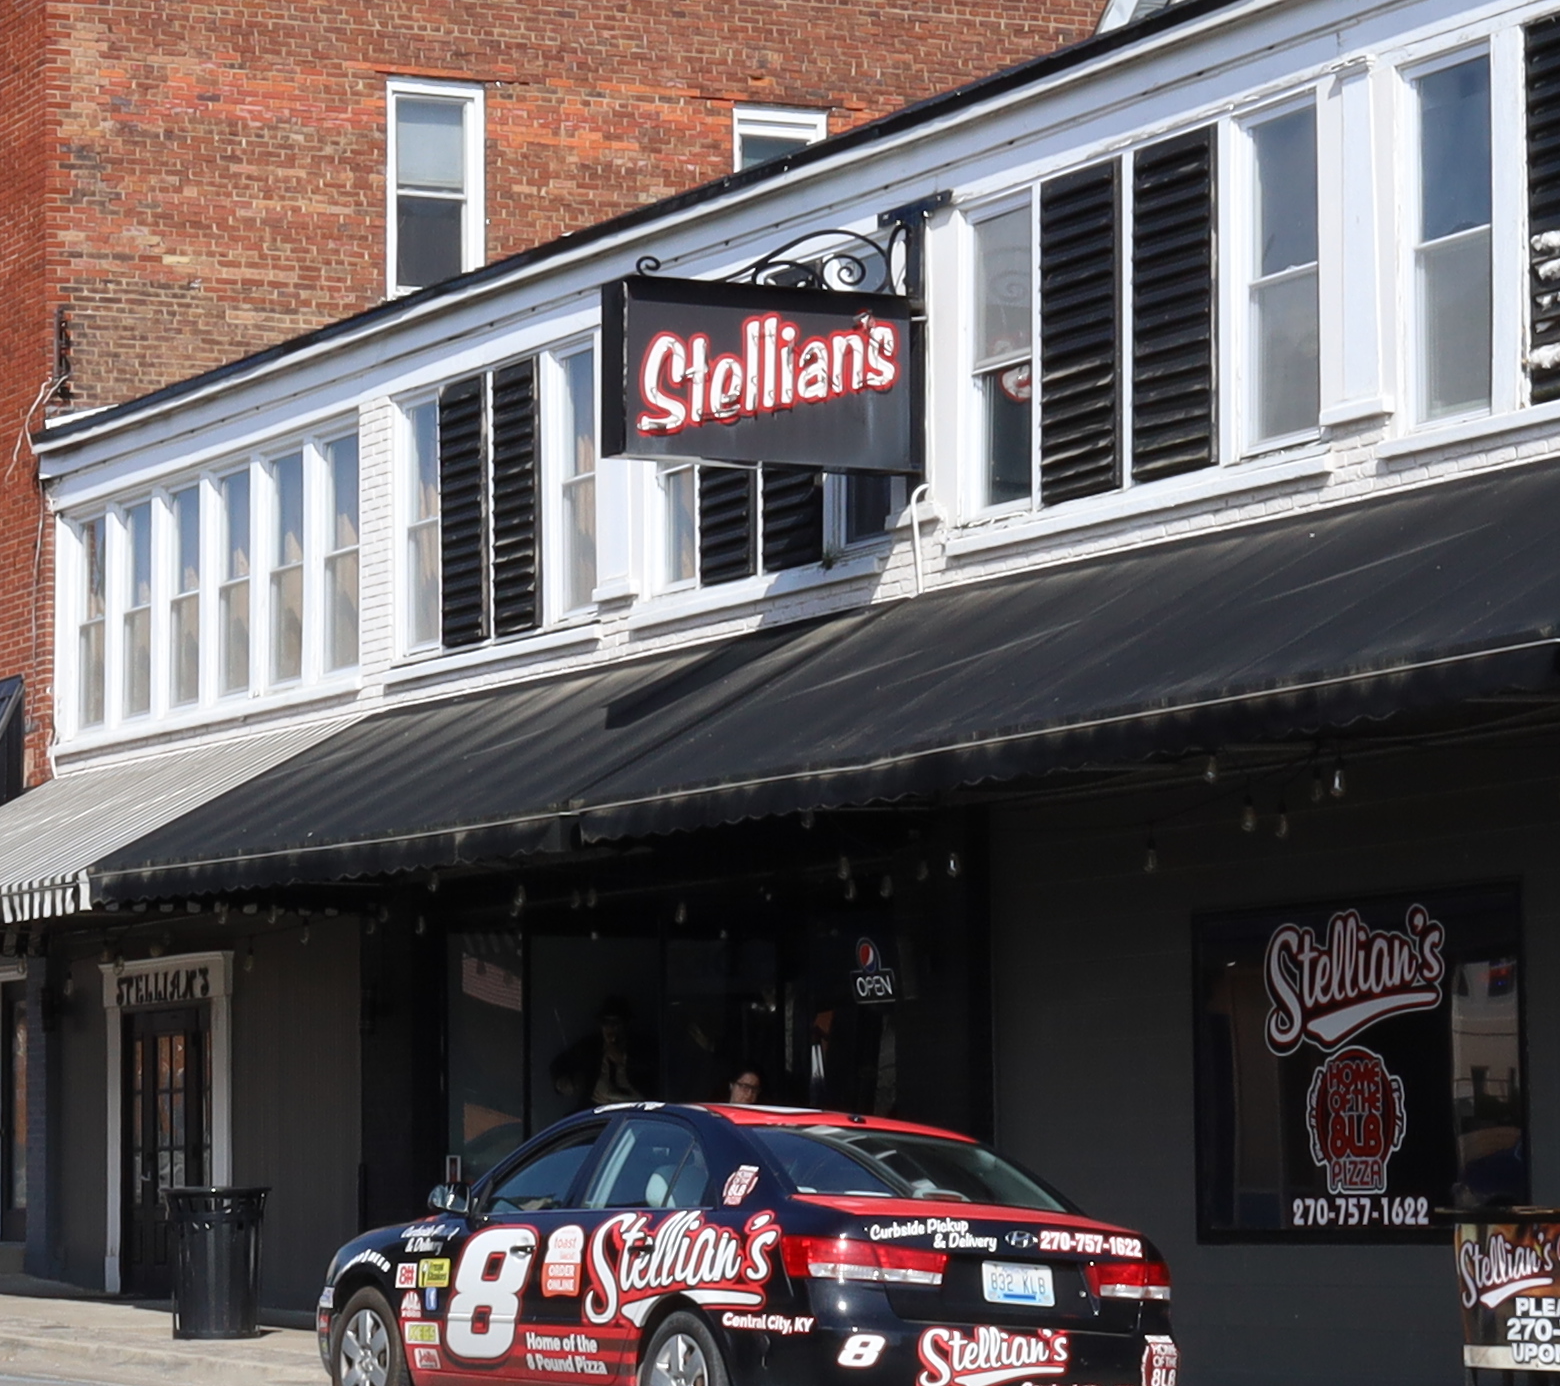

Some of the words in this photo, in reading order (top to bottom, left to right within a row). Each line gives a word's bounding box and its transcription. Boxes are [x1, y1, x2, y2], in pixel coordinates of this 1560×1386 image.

[856, 974, 893, 997] OPEN
[1268, 911, 1443, 1045] Stellian's
[1327, 1060, 1382, 1088] HOME
[1330, 1088, 1352, 1113] OF
[1351, 1086, 1382, 1113] THE
[1331, 1160, 1383, 1188] PIZZA
[1292, 1196, 1430, 1226] 270-757-1622
[869, 1220, 925, 1241] Curbside
[927, 1217, 969, 1236] Pickup
[933, 1234, 947, 1250] &
[948, 1235, 998, 1253] Delivery
[1040, 1230, 1143, 1258] 270-757-1622
[548, 1264, 576, 1277] ORDER
[584, 1210, 780, 1324] Stellian's
[1460, 1231, 1554, 1310] Stellian's
[445, 1226, 538, 1360] 8
[546, 1278, 575, 1291] ONLINE
[990, 1273, 1014, 1293] 832
[1022, 1275, 1047, 1295] KLB
[721, 1312, 765, 1331] Central
[766, 1314, 793, 1334] City,
[793, 1317, 814, 1333] KY
[525, 1332, 558, 1353] Home
[561, 1333, 576, 1353] of
[576, 1334, 598, 1353] the
[837, 1334, 883, 1368] 8
[526, 1354, 535, 1371] 8
[537, 1354, 573, 1374] Pound
[576, 1355, 608, 1375] Pizza
